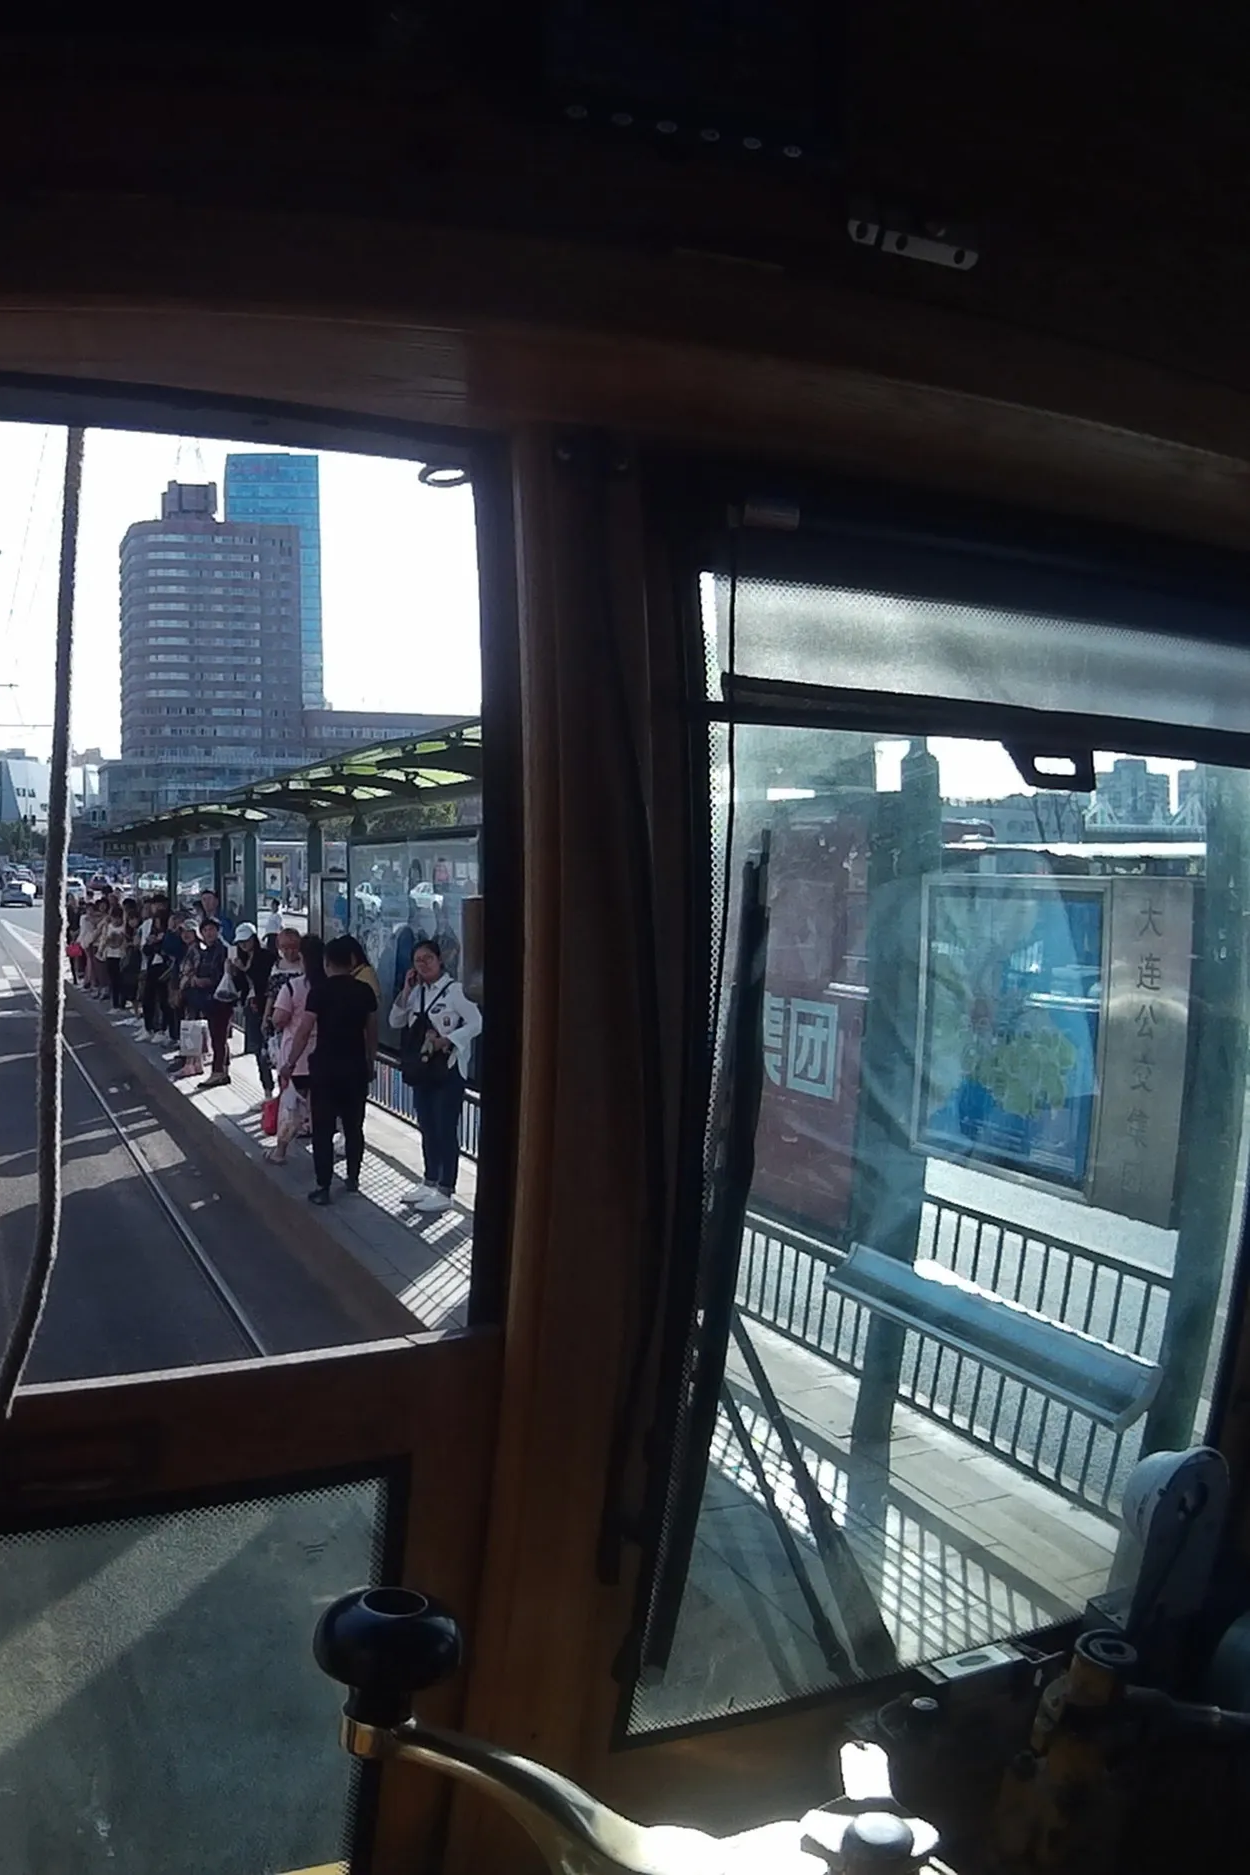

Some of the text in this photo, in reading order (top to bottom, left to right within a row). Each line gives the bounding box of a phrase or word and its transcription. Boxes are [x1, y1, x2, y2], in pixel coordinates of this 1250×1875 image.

[1121, 898, 1163, 1194] 大连公交集团
